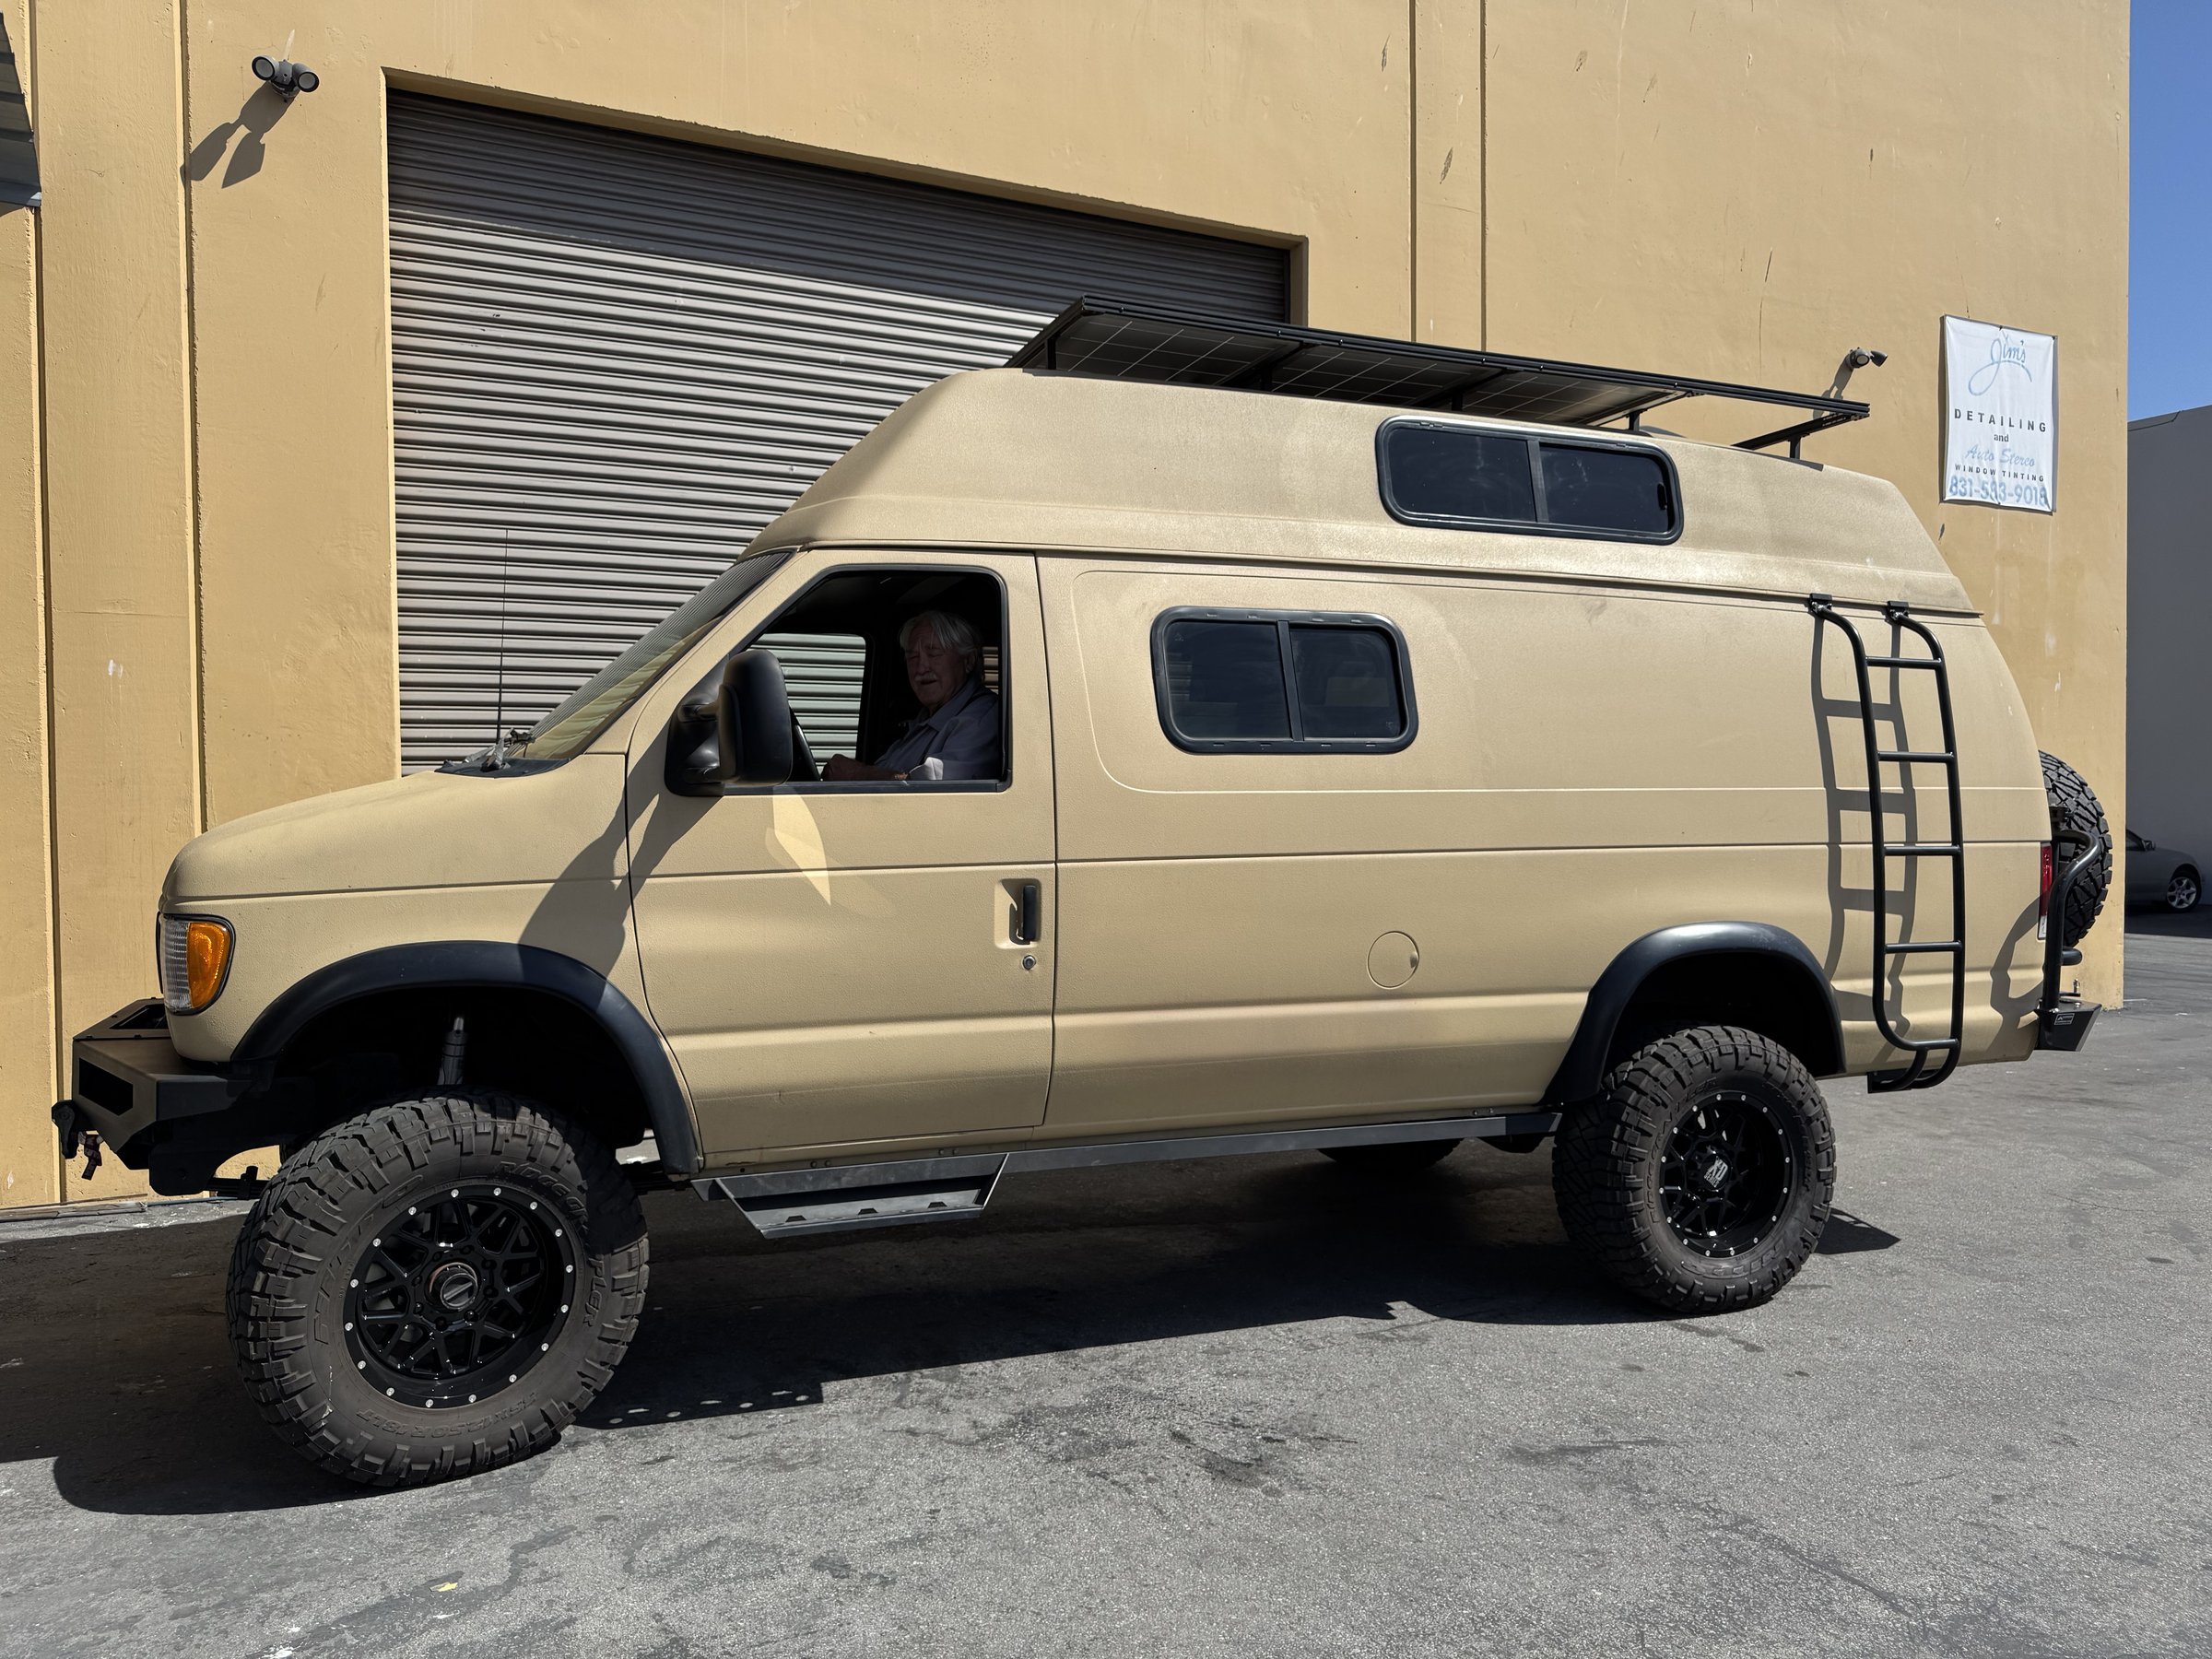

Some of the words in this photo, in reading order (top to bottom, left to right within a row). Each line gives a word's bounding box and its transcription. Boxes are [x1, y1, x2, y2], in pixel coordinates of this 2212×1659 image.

[1968, 337, 2032, 395] Jim's
[1954, 408, 2046, 433] DETAILING
[1994, 433, 2009, 442] and
[1965, 444, 1995, 462] Auto
[1999, 448, 2036, 467] Stereo
[1954, 464, 1996, 477] WINDOW
[2002, 470, 2044, 482] TINTING
